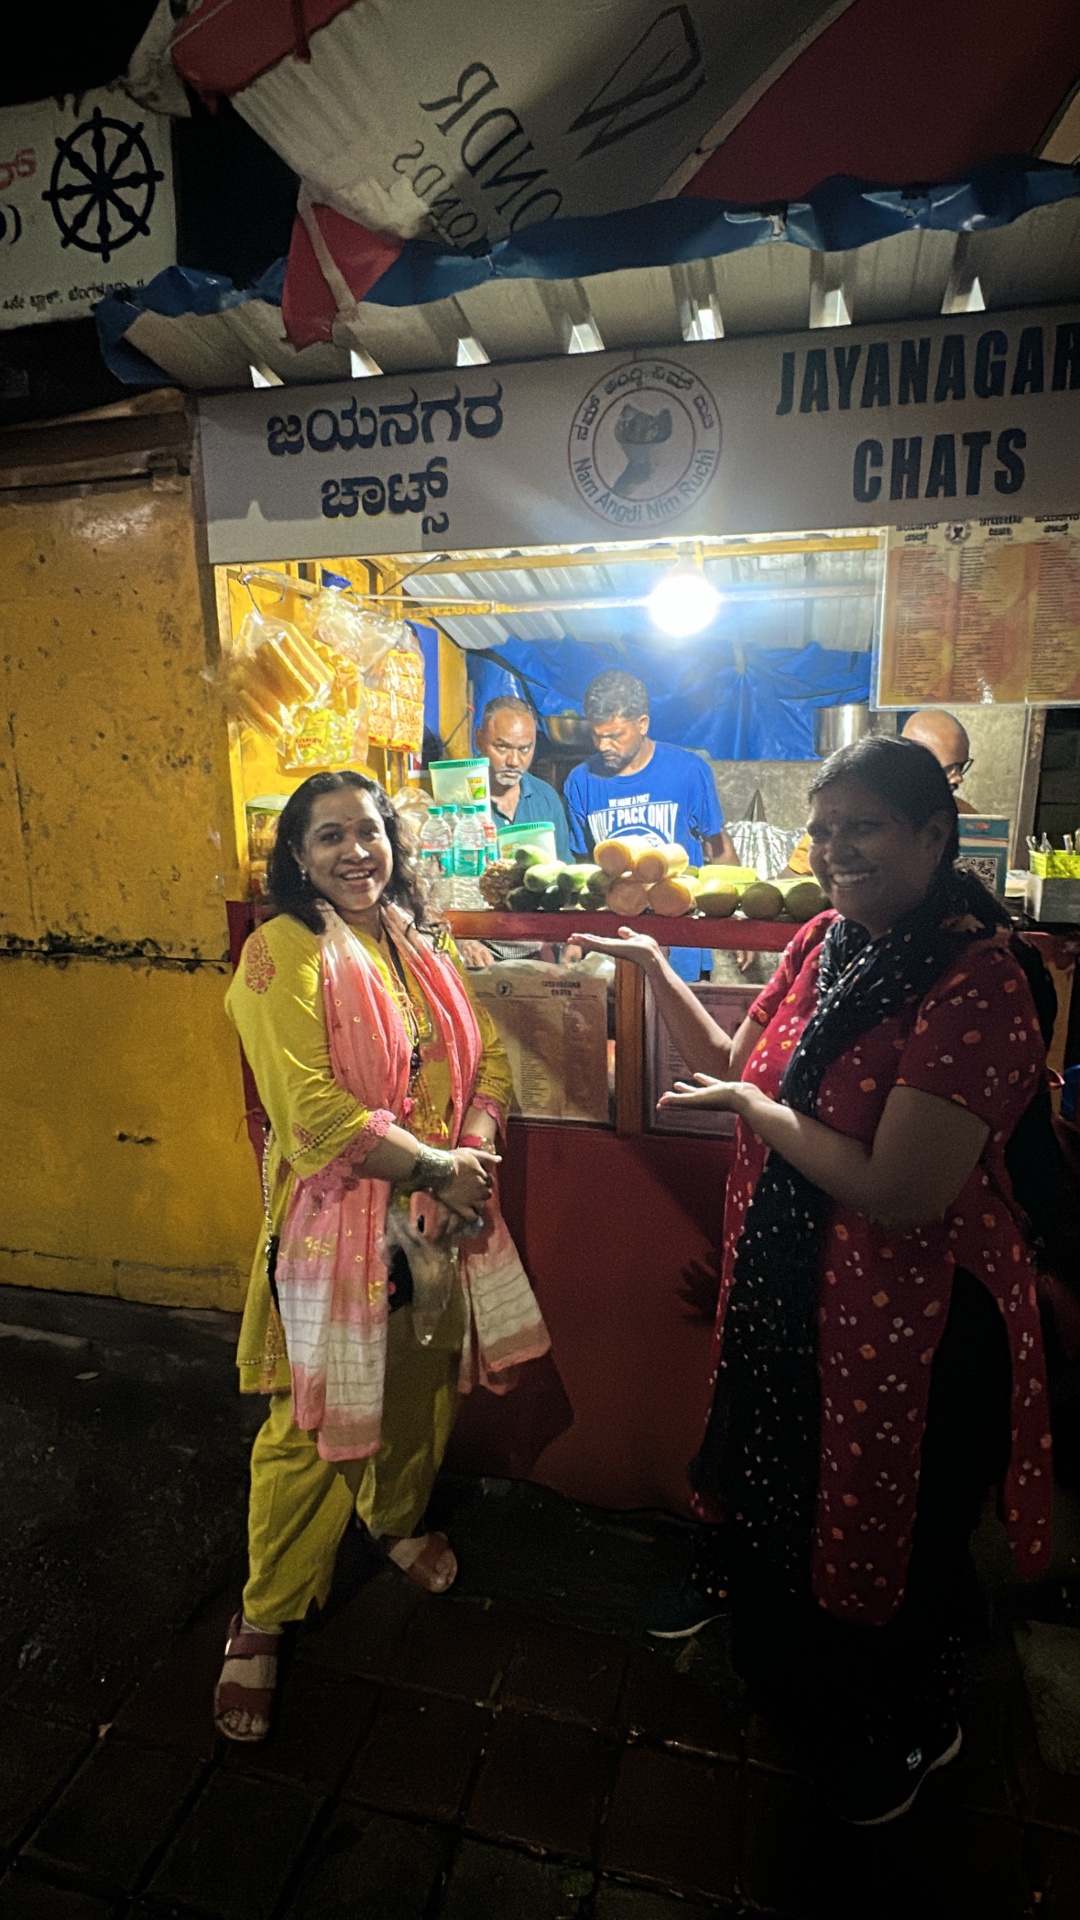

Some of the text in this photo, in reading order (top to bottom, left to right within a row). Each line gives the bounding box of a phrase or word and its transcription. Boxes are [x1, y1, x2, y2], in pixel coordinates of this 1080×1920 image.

[776, 322, 1080, 416] JAYANAGAR
[266, 377, 503, 457] ಜಯನಗರ
[320, 456, 450, 535] ಚಾಟ್ಸ್
[574, 457, 599, 498] Nam
[595, 492, 642, 523] Angdi
[679, 449, 715, 498] Ruchi
[853, 428, 1027, 503] CHATS
[587, 803, 679, 845] WOLF PACK ONLY
